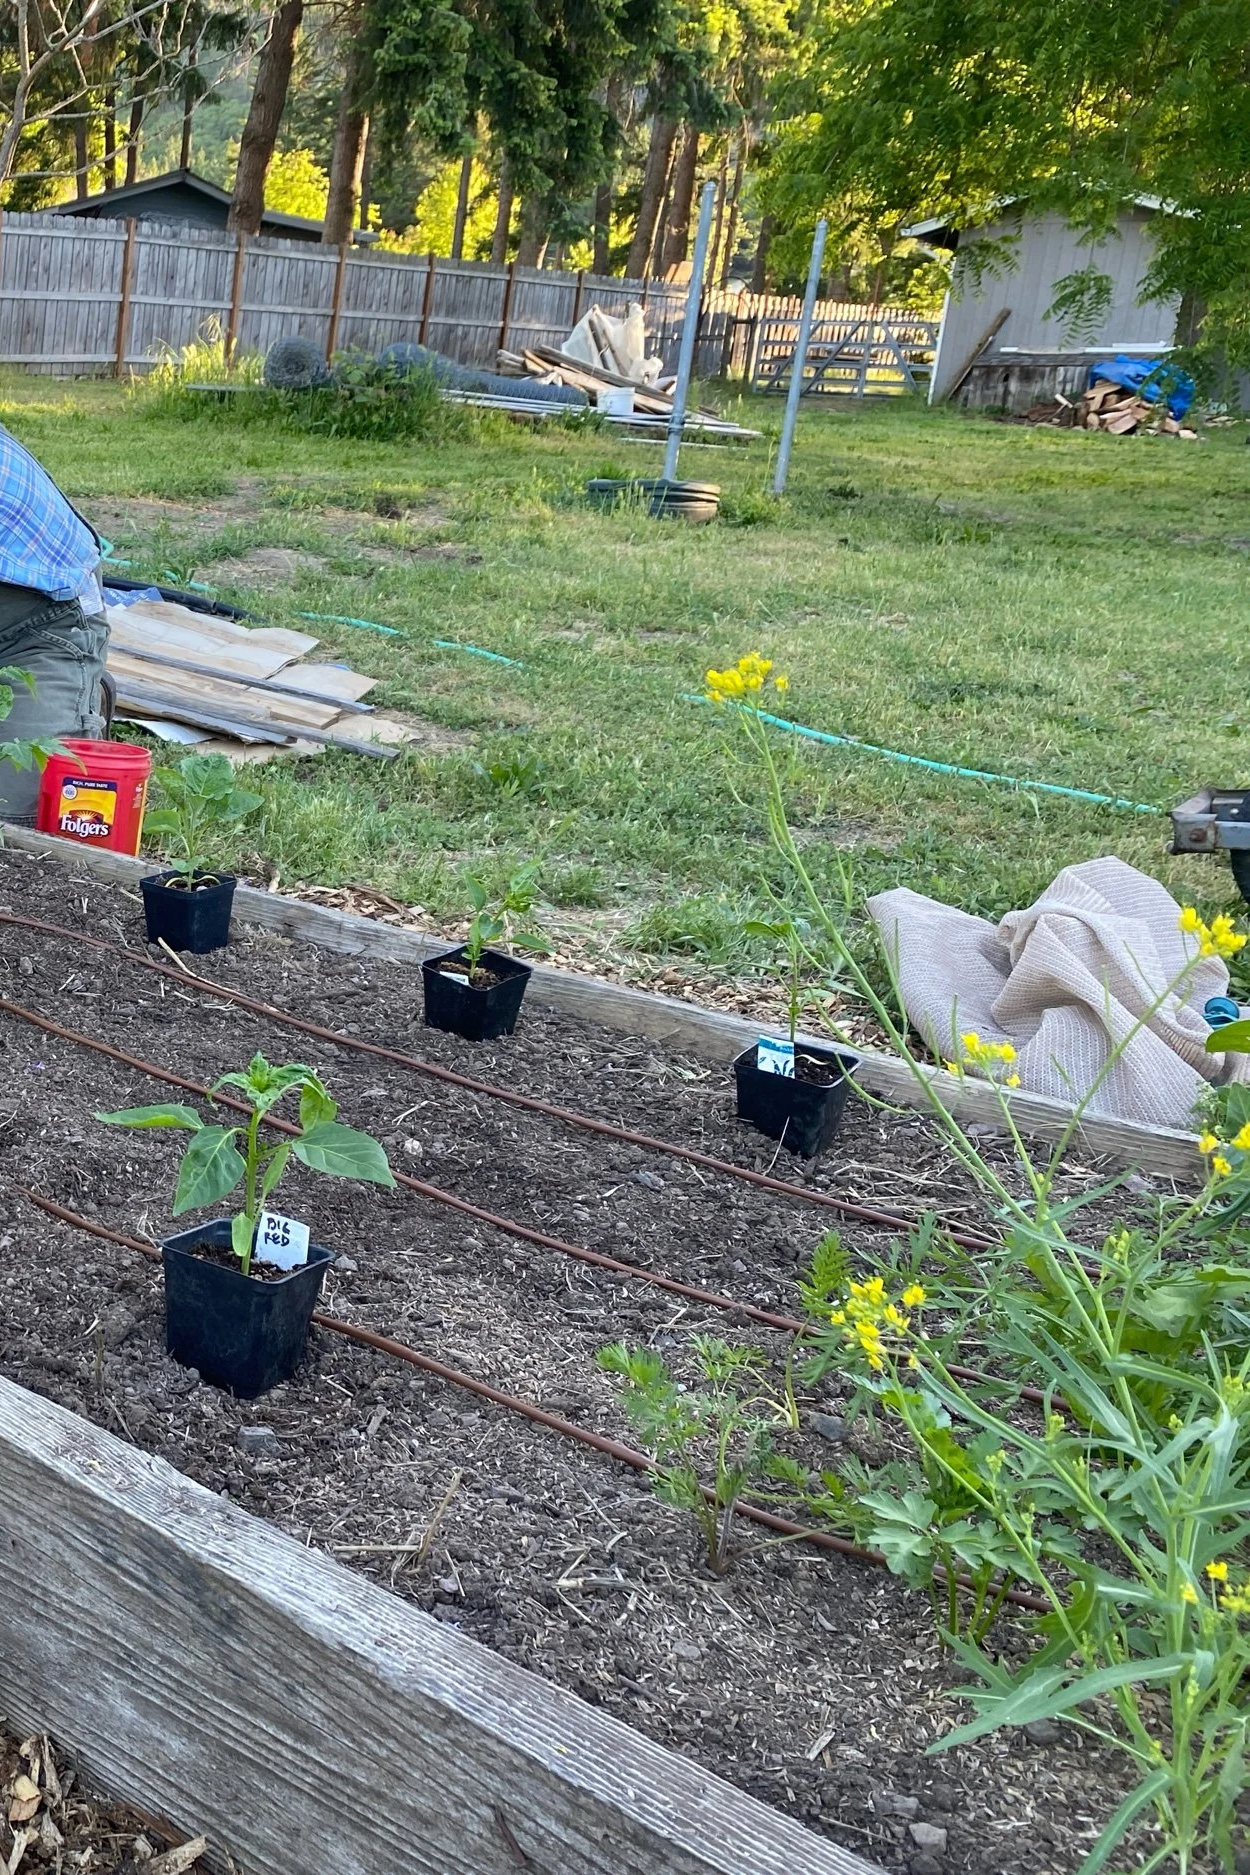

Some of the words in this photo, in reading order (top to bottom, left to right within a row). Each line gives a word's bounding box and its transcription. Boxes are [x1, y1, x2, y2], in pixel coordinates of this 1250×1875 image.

[60, 814, 109, 838] Folgers
[267, 1217, 291, 1235] BIG
[264, 1231, 290, 1247] RED
